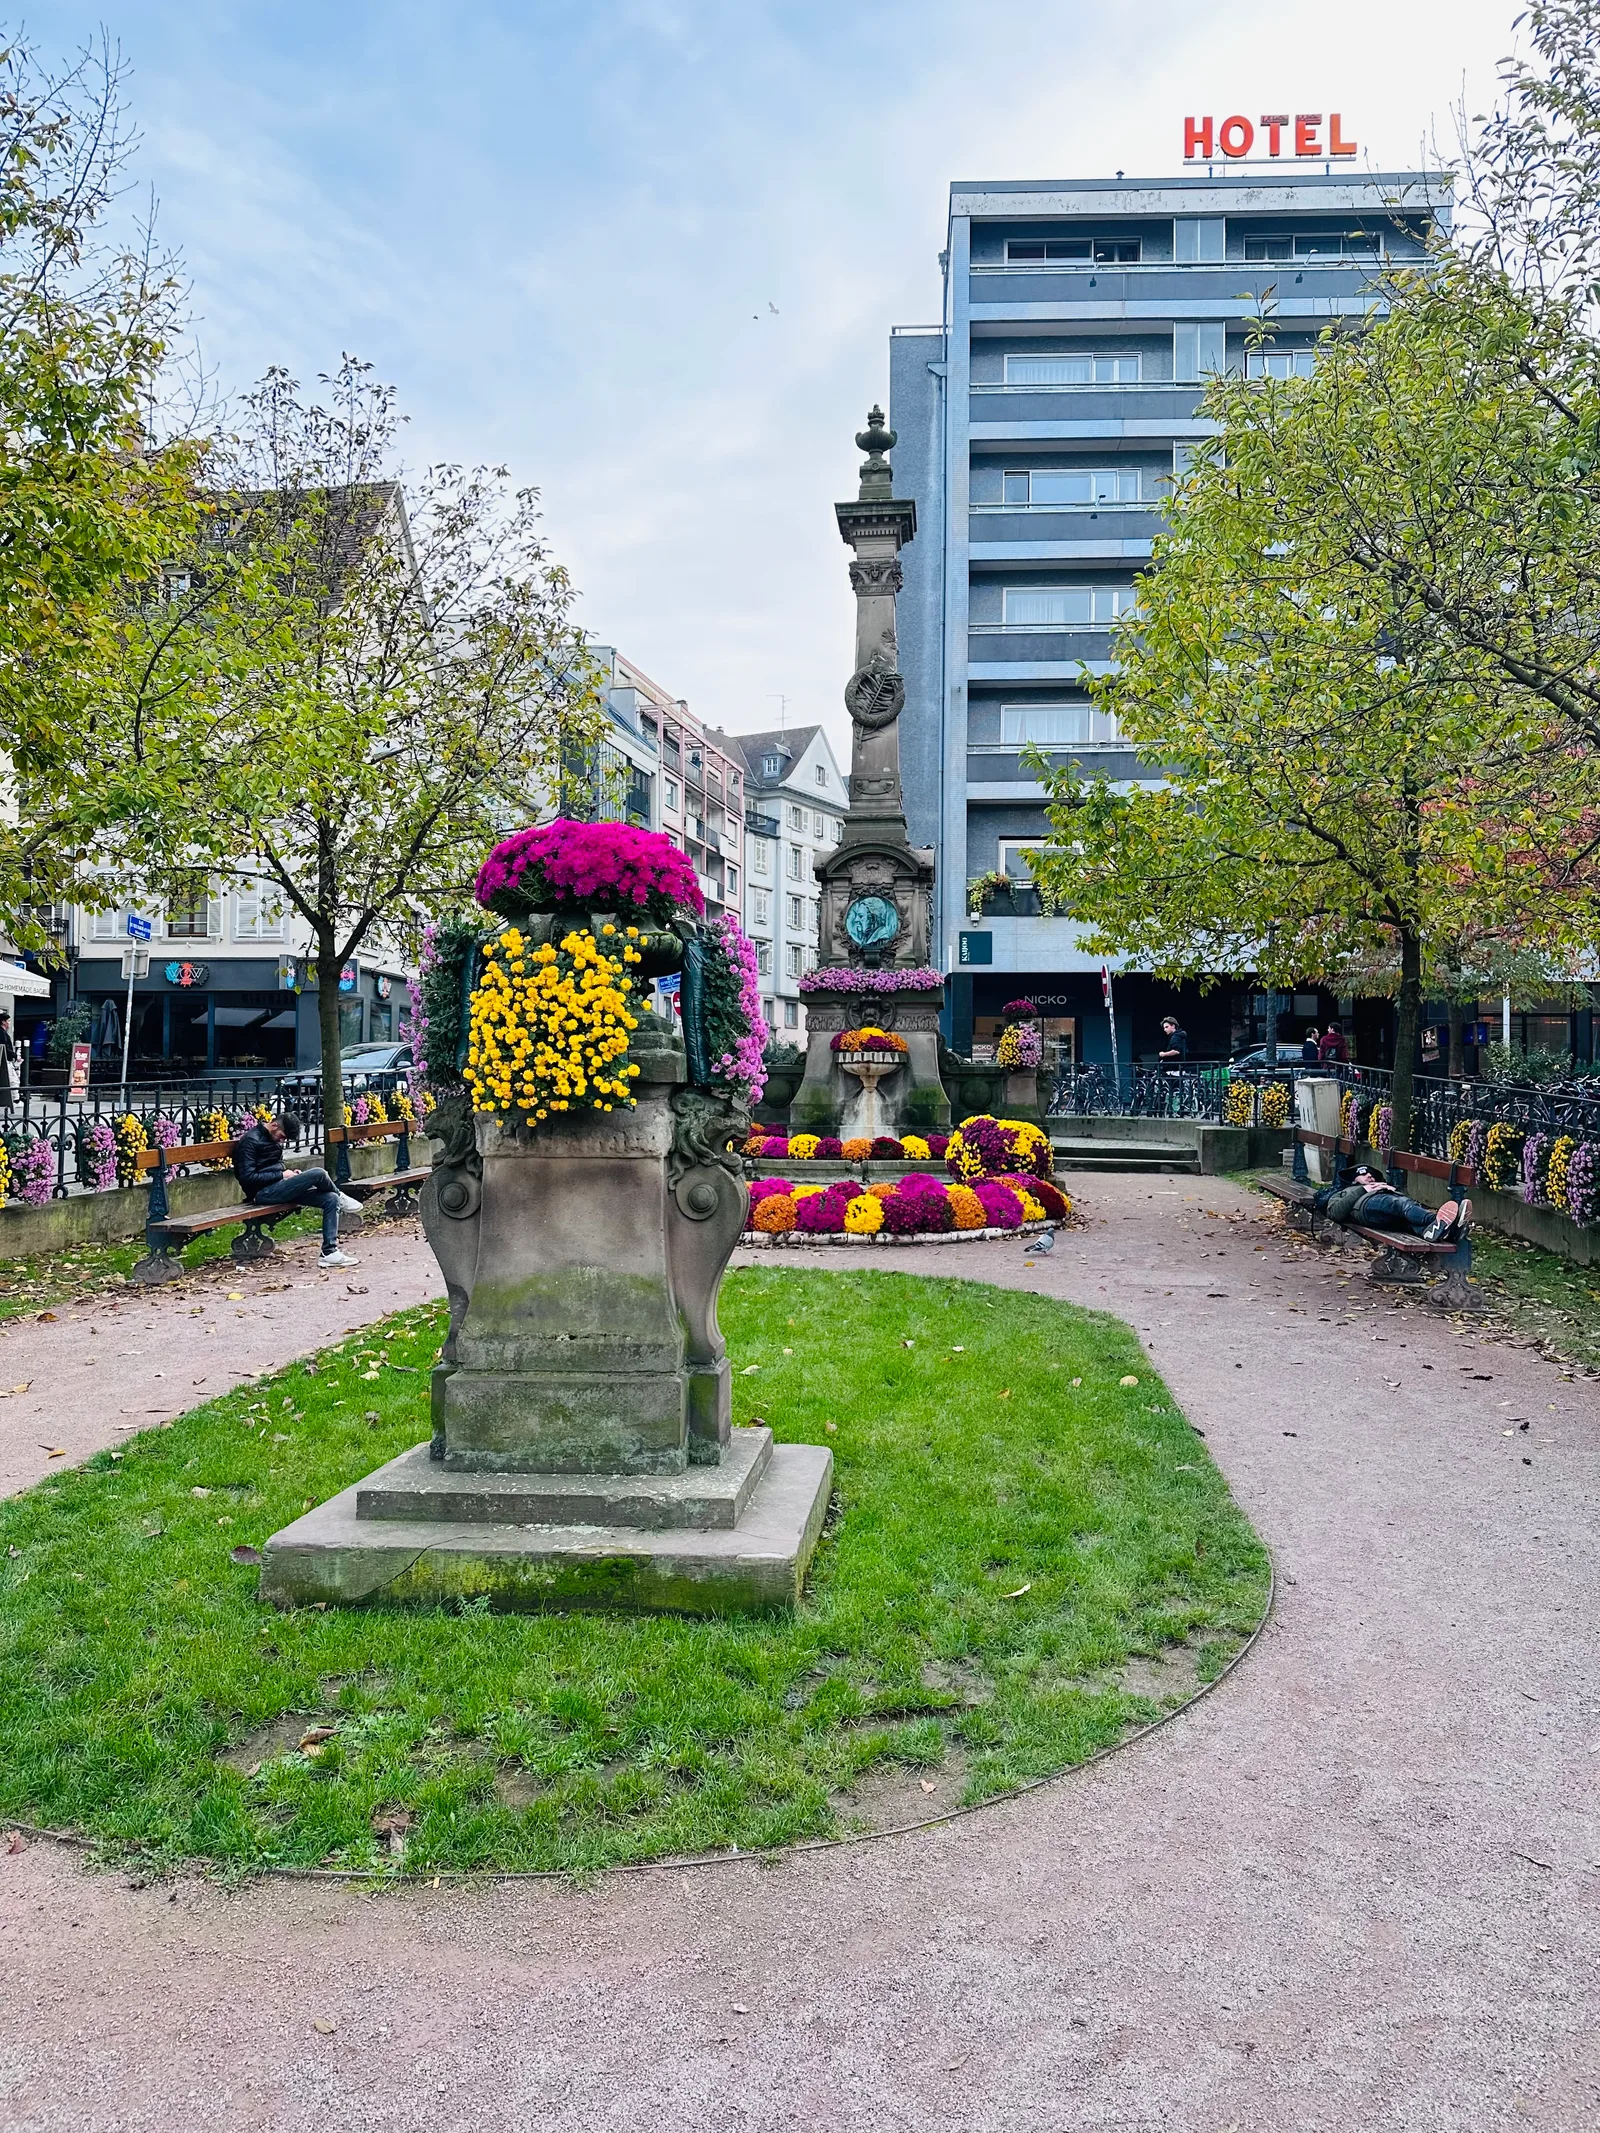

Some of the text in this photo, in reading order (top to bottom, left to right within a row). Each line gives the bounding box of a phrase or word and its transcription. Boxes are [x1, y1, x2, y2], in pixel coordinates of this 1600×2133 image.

[1184, 113, 1358, 158] HOTEL
[4, 983, 33, 993] HOMEMADE
[1024, 995, 1067, 1005] NICKO
